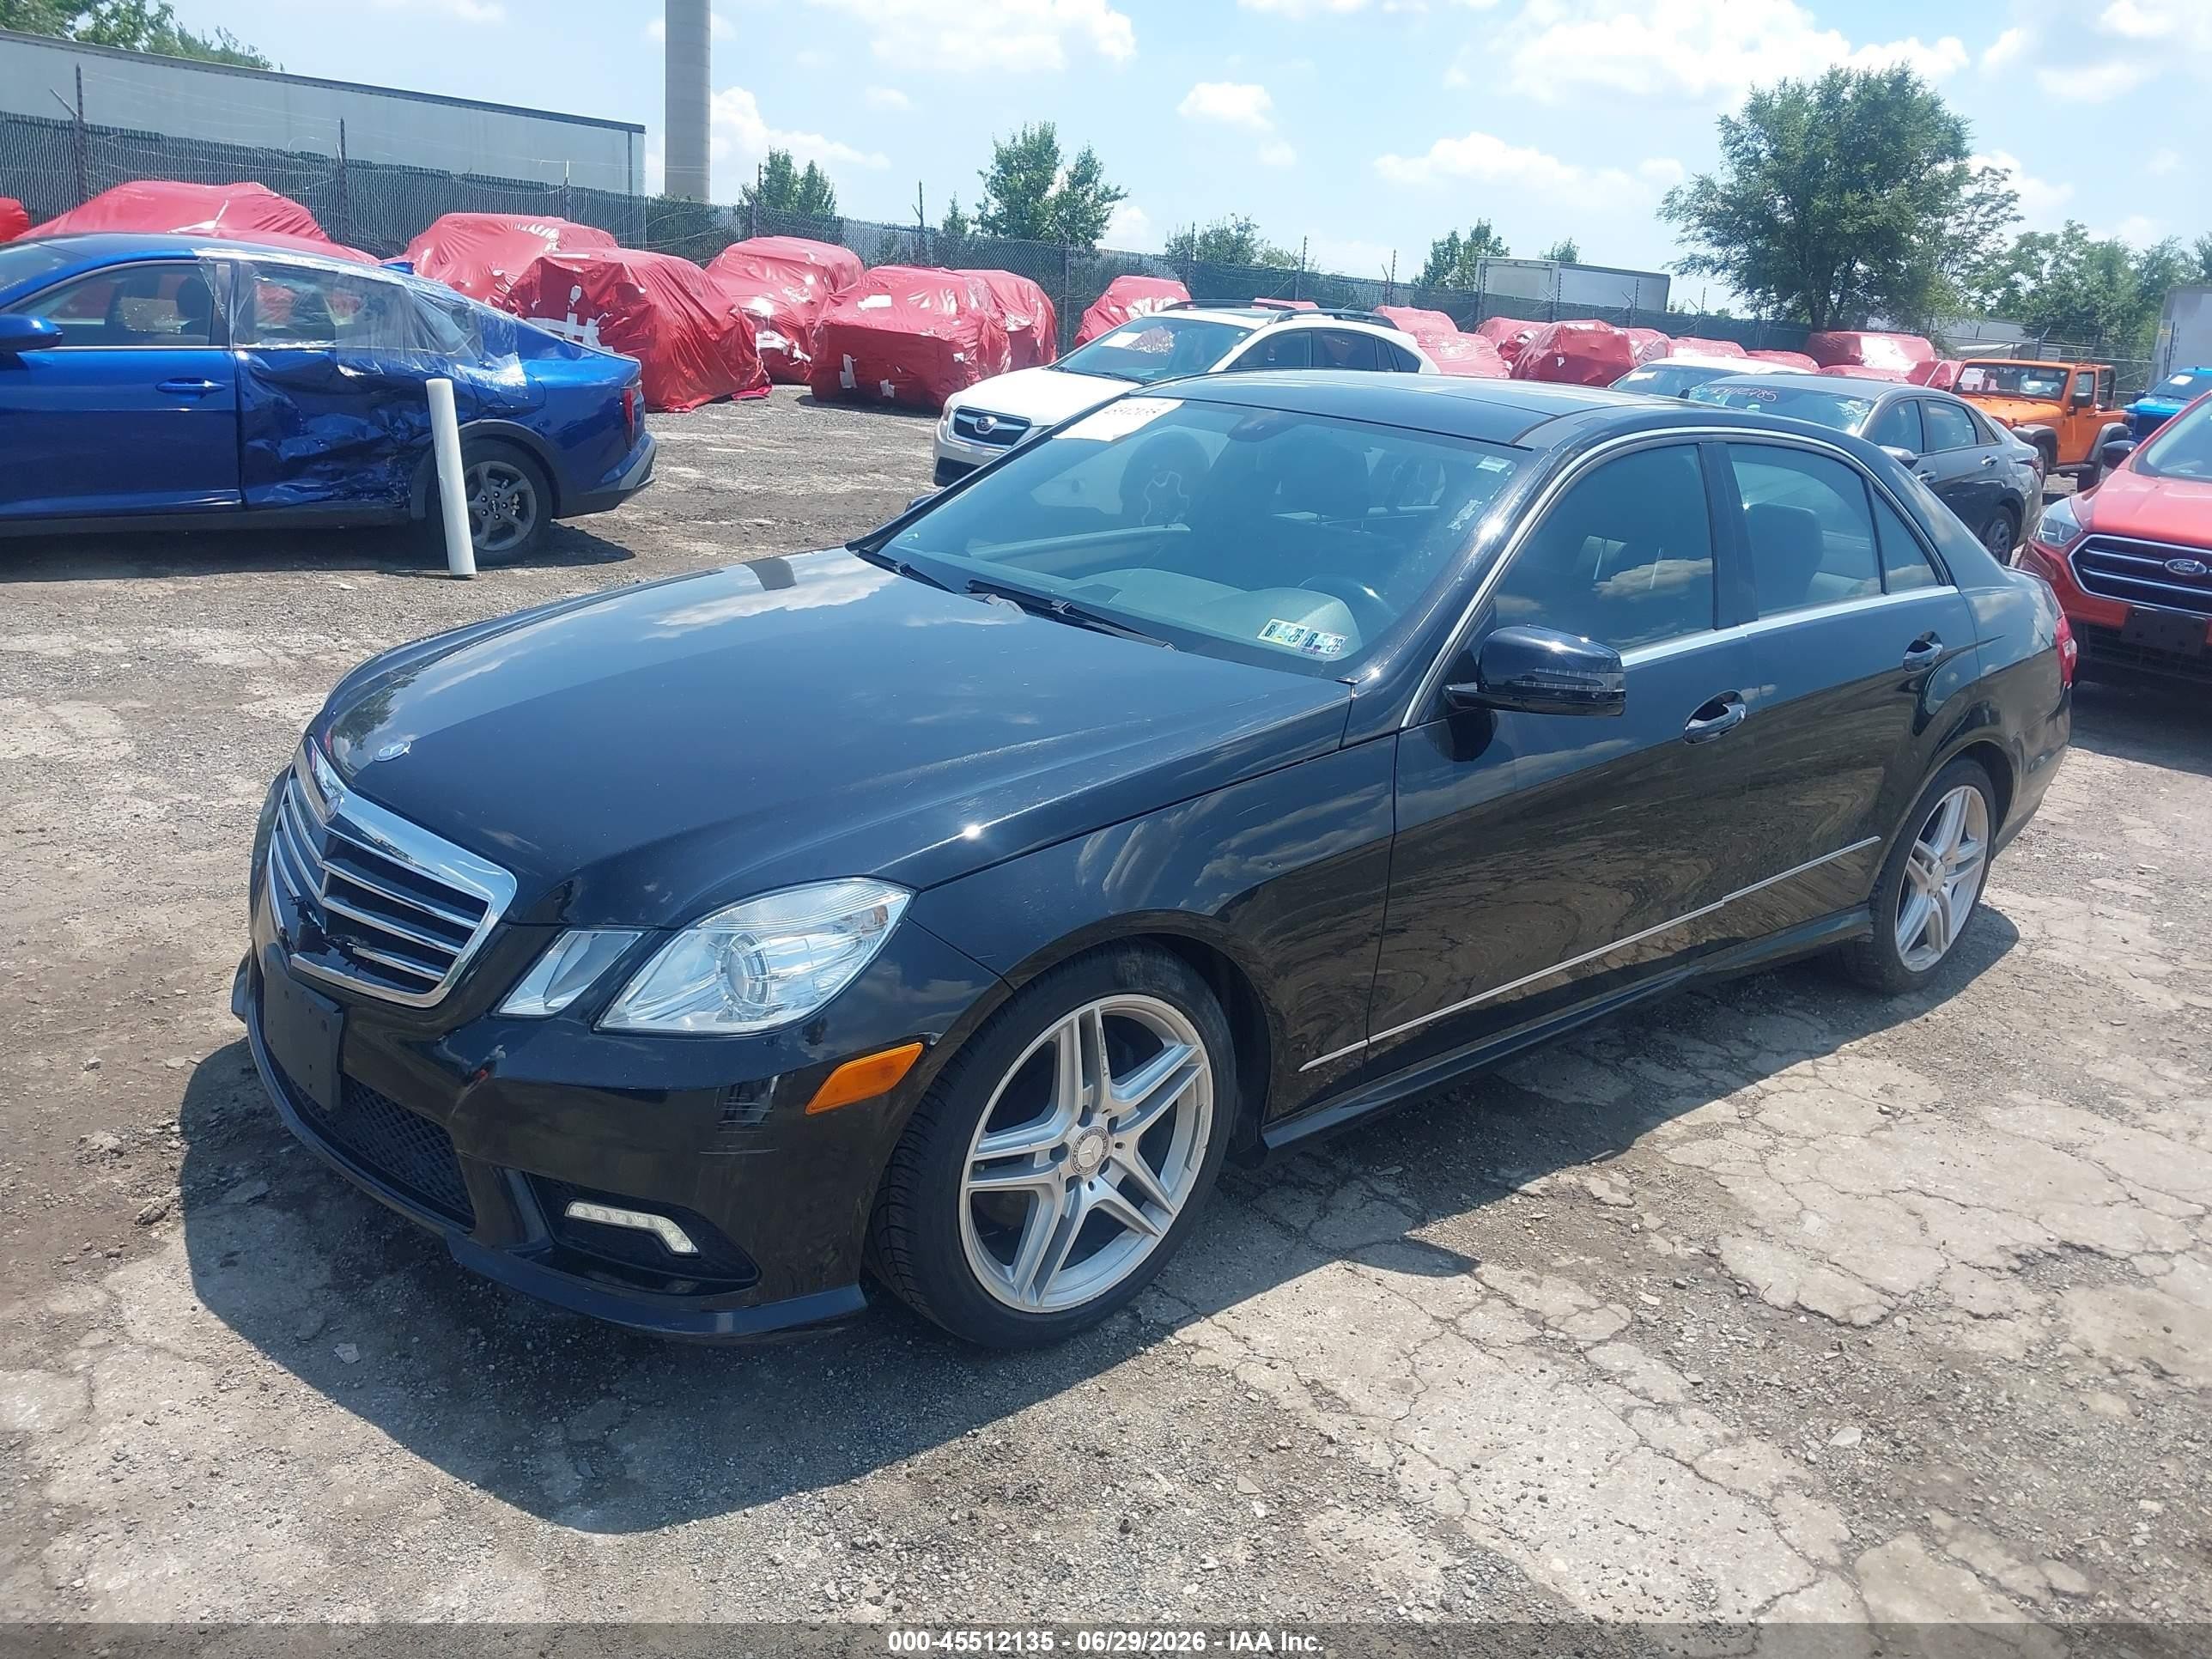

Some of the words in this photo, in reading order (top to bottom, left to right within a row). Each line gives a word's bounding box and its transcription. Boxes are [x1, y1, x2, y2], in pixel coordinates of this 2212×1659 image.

[2173, 561, 2198, 572] Ford
[1265, 624, 1276, 637] 6
[1288, 628, 1304, 642] 26
[1304, 632, 1319, 647] 6
[1326, 637, 1343, 652] 26
